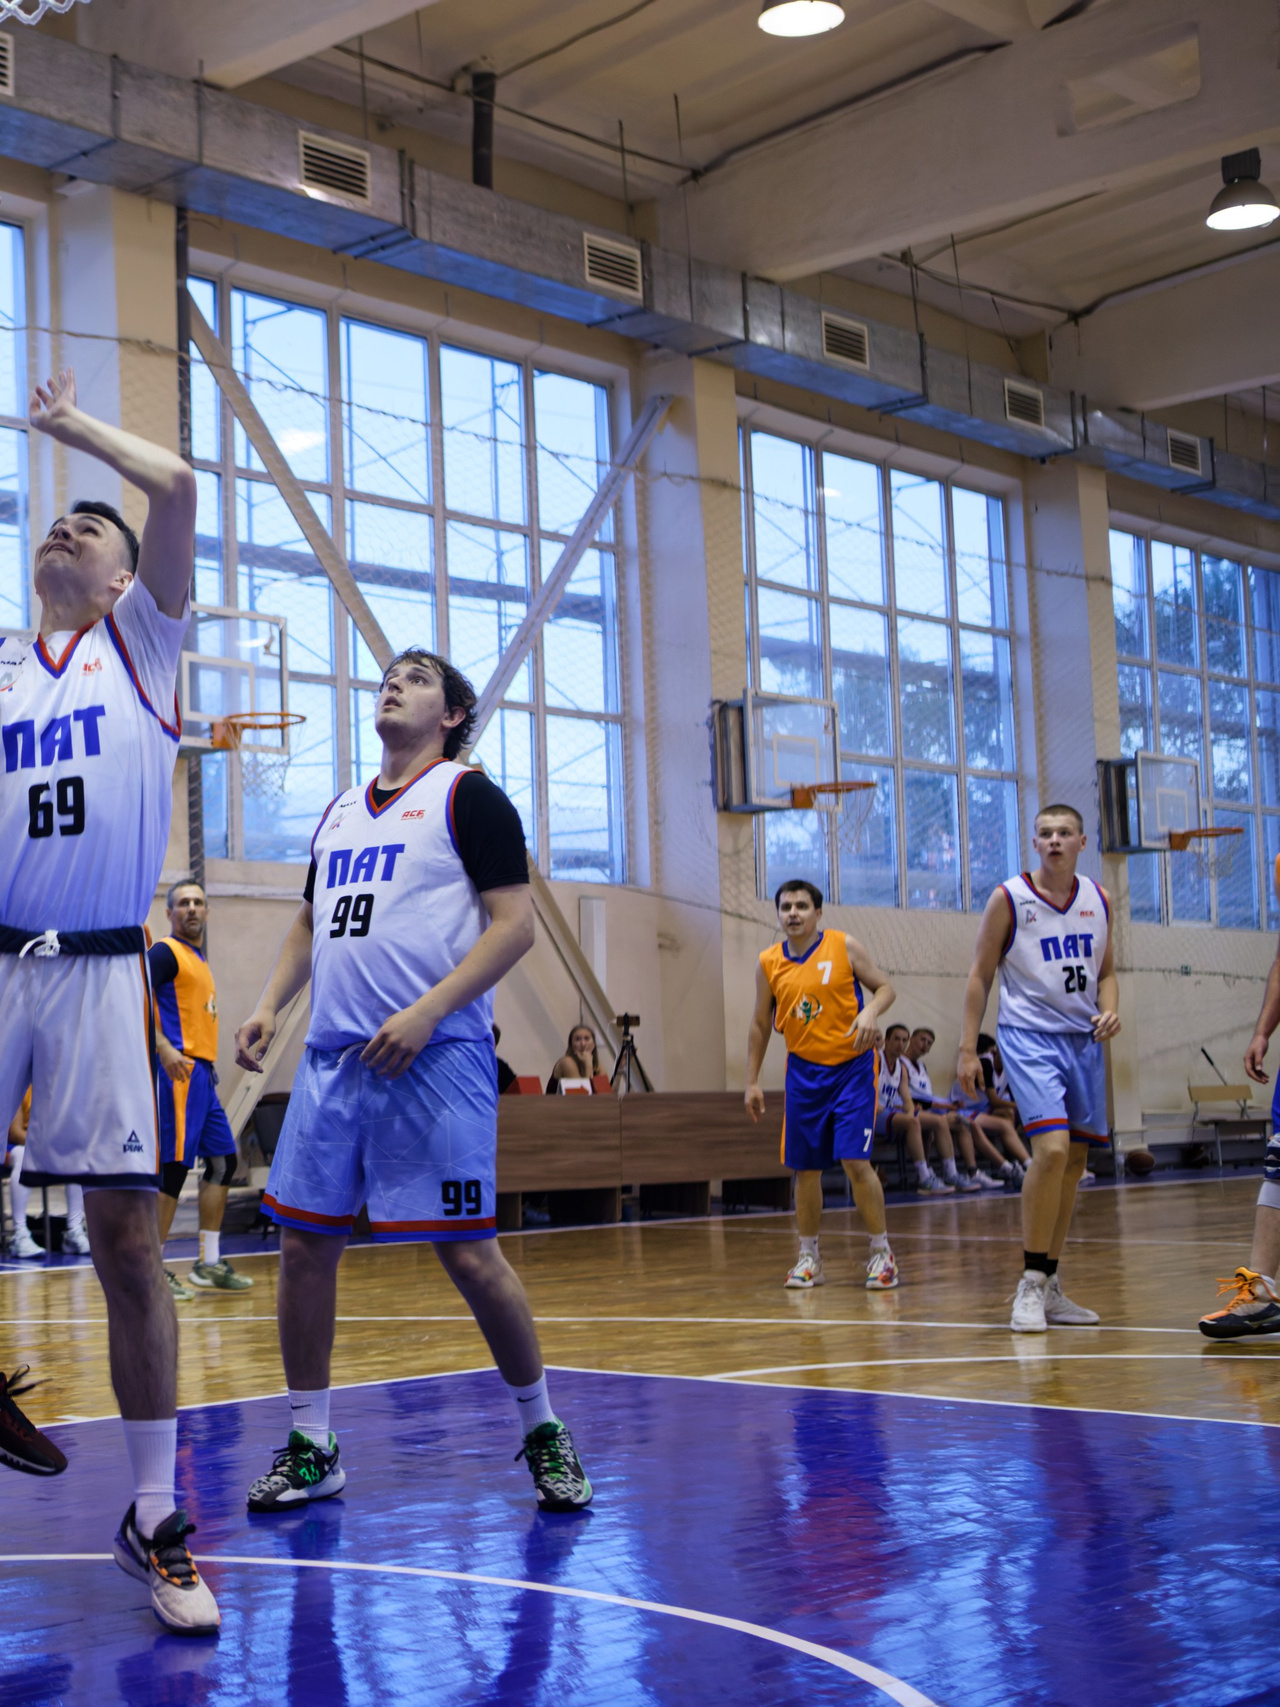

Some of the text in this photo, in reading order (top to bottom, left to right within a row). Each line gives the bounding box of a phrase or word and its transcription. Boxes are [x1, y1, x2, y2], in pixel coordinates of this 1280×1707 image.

[2, 705, 106, 774] ПАТ
[28, 776, 85, 839] 69
[326, 843, 406, 890] ПАТ
[330, 893, 375, 939] 99
[1040, 933, 1094, 962] ПАТ
[817, 960, 833, 986] 7
[1062, 965, 1087, 994] 26
[863, 1127, 872, 1152] 7
[441, 1180, 482, 1216] 99
